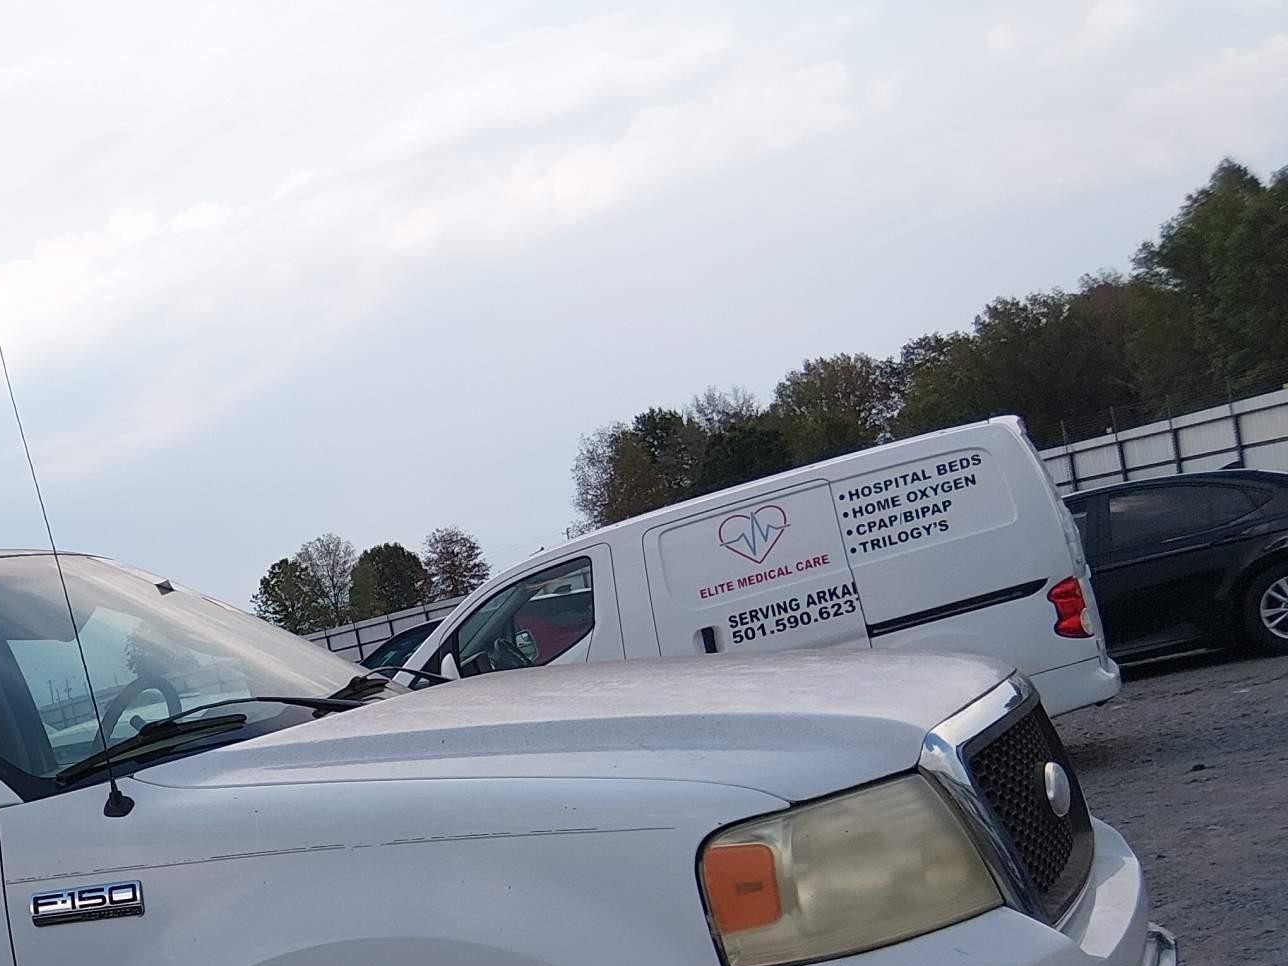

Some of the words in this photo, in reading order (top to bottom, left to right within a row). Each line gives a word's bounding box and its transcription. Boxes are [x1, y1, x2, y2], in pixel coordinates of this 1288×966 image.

[848, 470, 931, 501] HOSPITAL
[936, 455, 981, 475] BEDS
[852, 496, 901, 518] HOME
[907, 475, 976, 502] OXYGEN
[856, 500, 952, 535] CPAP/BIPAP
[859, 520, 949, 552] TRILOGY'S
[700, 581, 734, 599] ELITE
[737, 566, 792, 588] MEDICAL
[796, 554, 830, 571] CARE
[729, 598, 800, 628] SERVING
[733, 597, 860, 643] 501.590.623
[33, 884, 138, 914] F-150
